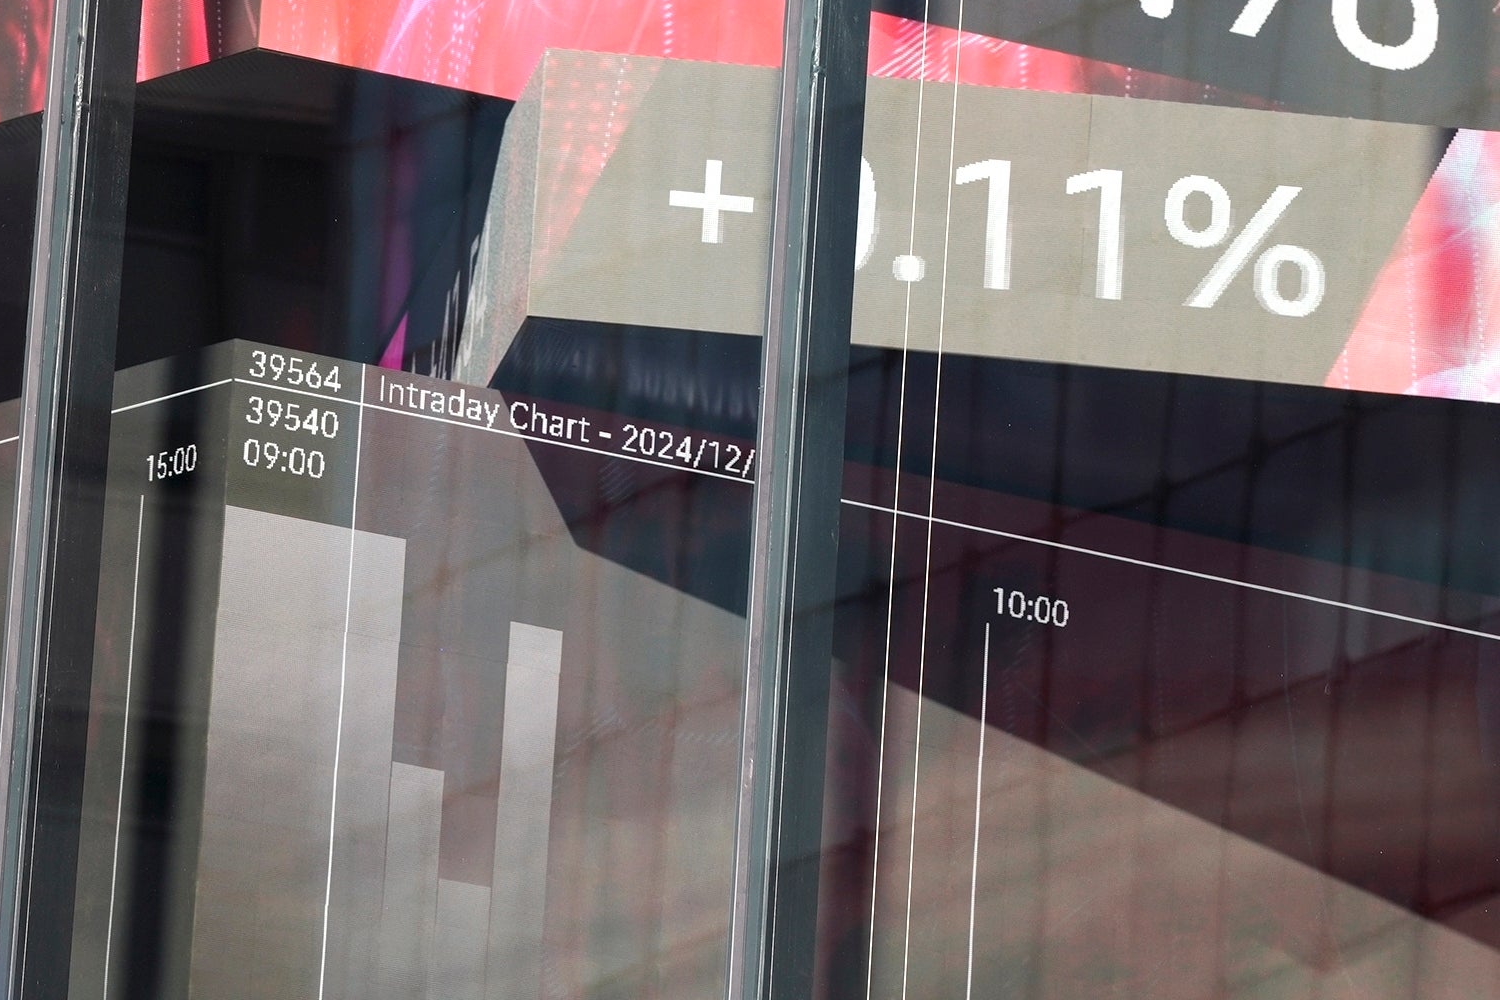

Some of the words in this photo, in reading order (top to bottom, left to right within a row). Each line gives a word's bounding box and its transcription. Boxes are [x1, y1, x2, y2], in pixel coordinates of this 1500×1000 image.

[669, 156, 1325, 317] +.11%
[248, 350, 341, 392] 39564
[245, 396, 339, 439] 39540
[380, 374, 500, 428] Intraday
[510, 402, 591, 444] Chart
[146, 444, 197, 482] 15:00
[243, 438, 325, 479] 09:00
[993, 586, 1069, 628] 10:00
